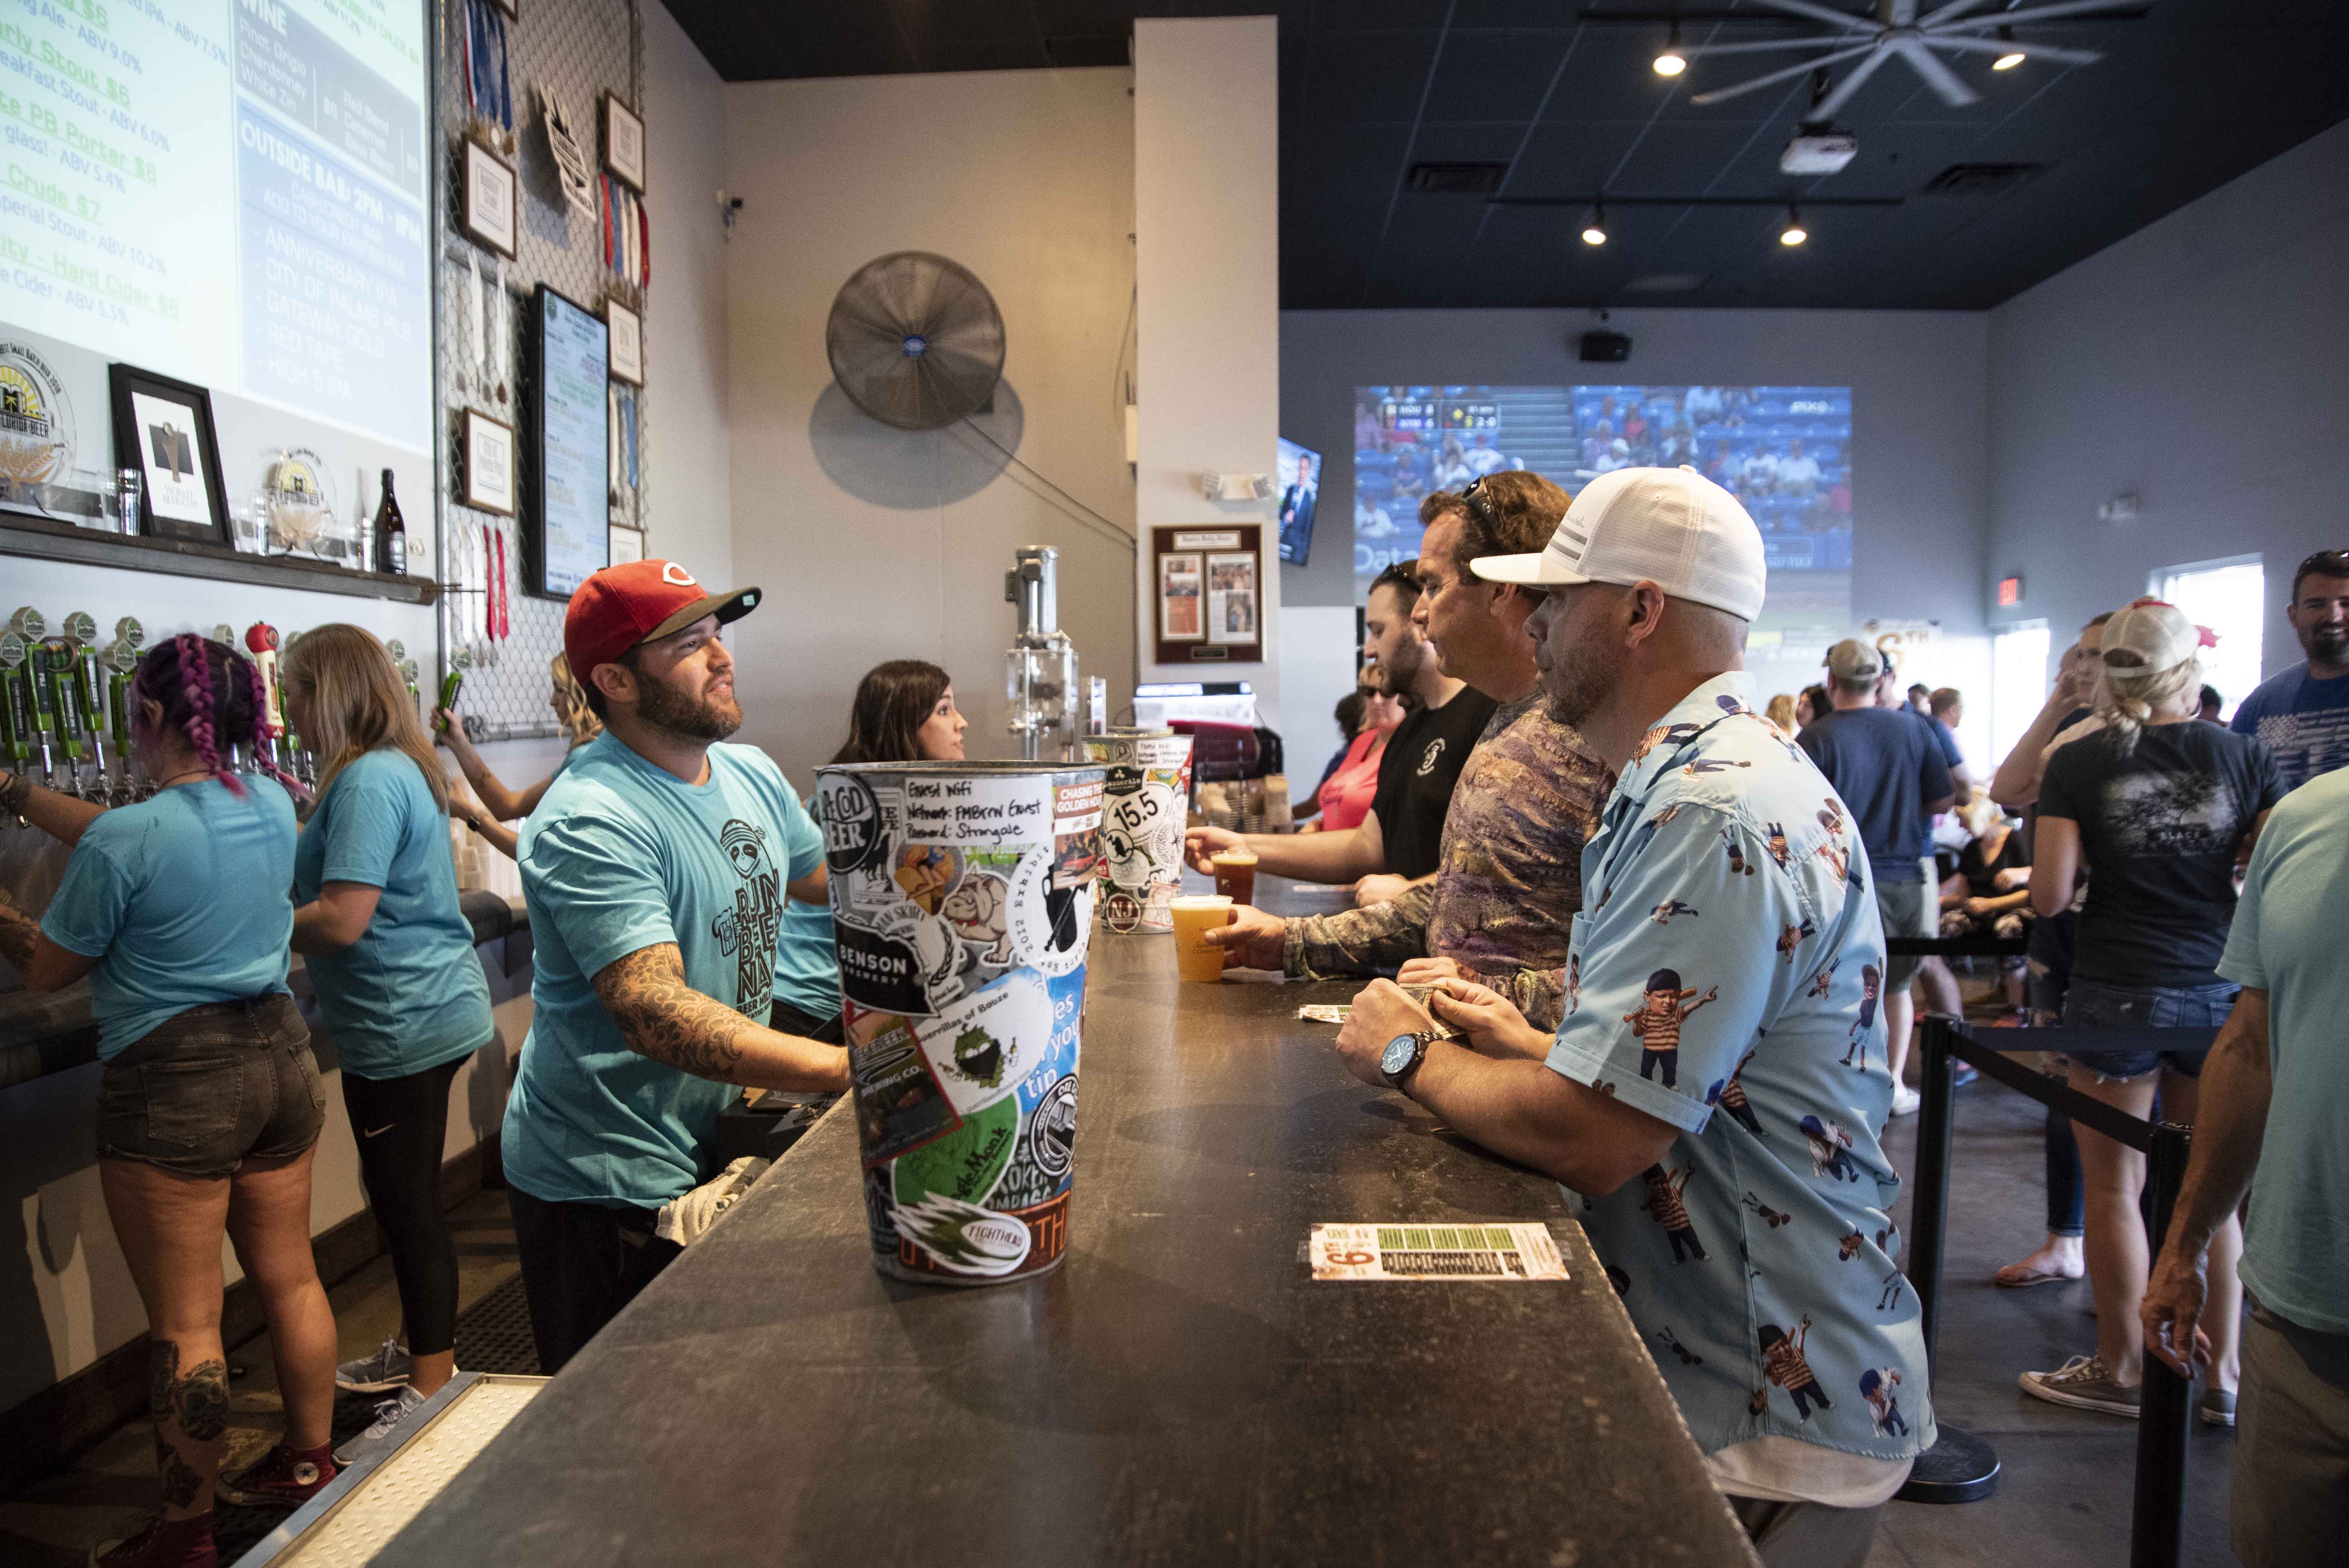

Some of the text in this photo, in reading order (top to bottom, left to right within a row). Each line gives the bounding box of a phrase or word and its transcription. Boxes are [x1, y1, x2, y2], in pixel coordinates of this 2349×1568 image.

[42, 2, 66, 29] Ale
[78, 24, 107, 53] ABV
[110, 42, 143, 75] 9.0%
[145, 3, 228, 67] IPA ABV 7.5%
[42, 40, 98, 88] Stout
[241, 41, 306, 100] Chardonnay
[241, 62, 276, 99] White
[0, 50, 171, 153] eakfast Stout ABV 6.0%
[5, 124, 126, 194] glass! ABV 5.4%
[30, 101, 58, 135] PB
[66, 121, 128, 165] Porter
[8, 163, 101, 220] Crude $7
[241, 119, 311, 182] OUTSIDE
[354, 188, 384, 224] 2PM
[0, 195, 167, 276] perial Stout ABV 10.2%
[53, 252, 99, 288] Hard
[106, 272, 152, 308] Cider
[266, 225, 398, 310] ANNIVERSARY IPA
[266, 257, 300, 291] CITY
[305, 275, 326, 302] OF
[329, 286, 379, 328] PALMS
[14, 269, 54, 297] Cider
[65, 288, 94, 313] ABV
[98, 298, 129, 326] 5.5%
[267, 286, 385, 359] GATEWAY GOLD
[268, 321, 345, 371] RED TAPE
[268, 352, 309, 388] HIGH
[329, 375, 353, 404] IPA
[31, 420, 49, 439] BEER
[663, 562, 696, 586] C
[909, 781, 941, 797] Guest
[1009, 799, 1042, 817] Guest
[1057, 799, 1089, 813] GOLDEN
[1060, 785, 1093, 801] CHASING
[1114, 791, 1159, 831] 15.5
[735, 868, 780, 925] RUN
[1111, 901, 1133, 918] NJ
[739, 904, 783, 965] BEER
[840, 945, 907, 975] BENSON
[843, 965, 899, 986] BREWERY
[965, 1009, 976, 1021] of
[978, 991, 1009, 1014] Booze
[1025, 1067, 1058, 1099] tip
[952, 1126, 1008, 1199] agleMonk
[968, 1225, 1023, 1247] TIGHTHEAD
[1327, 1250, 1375, 1266] 6
